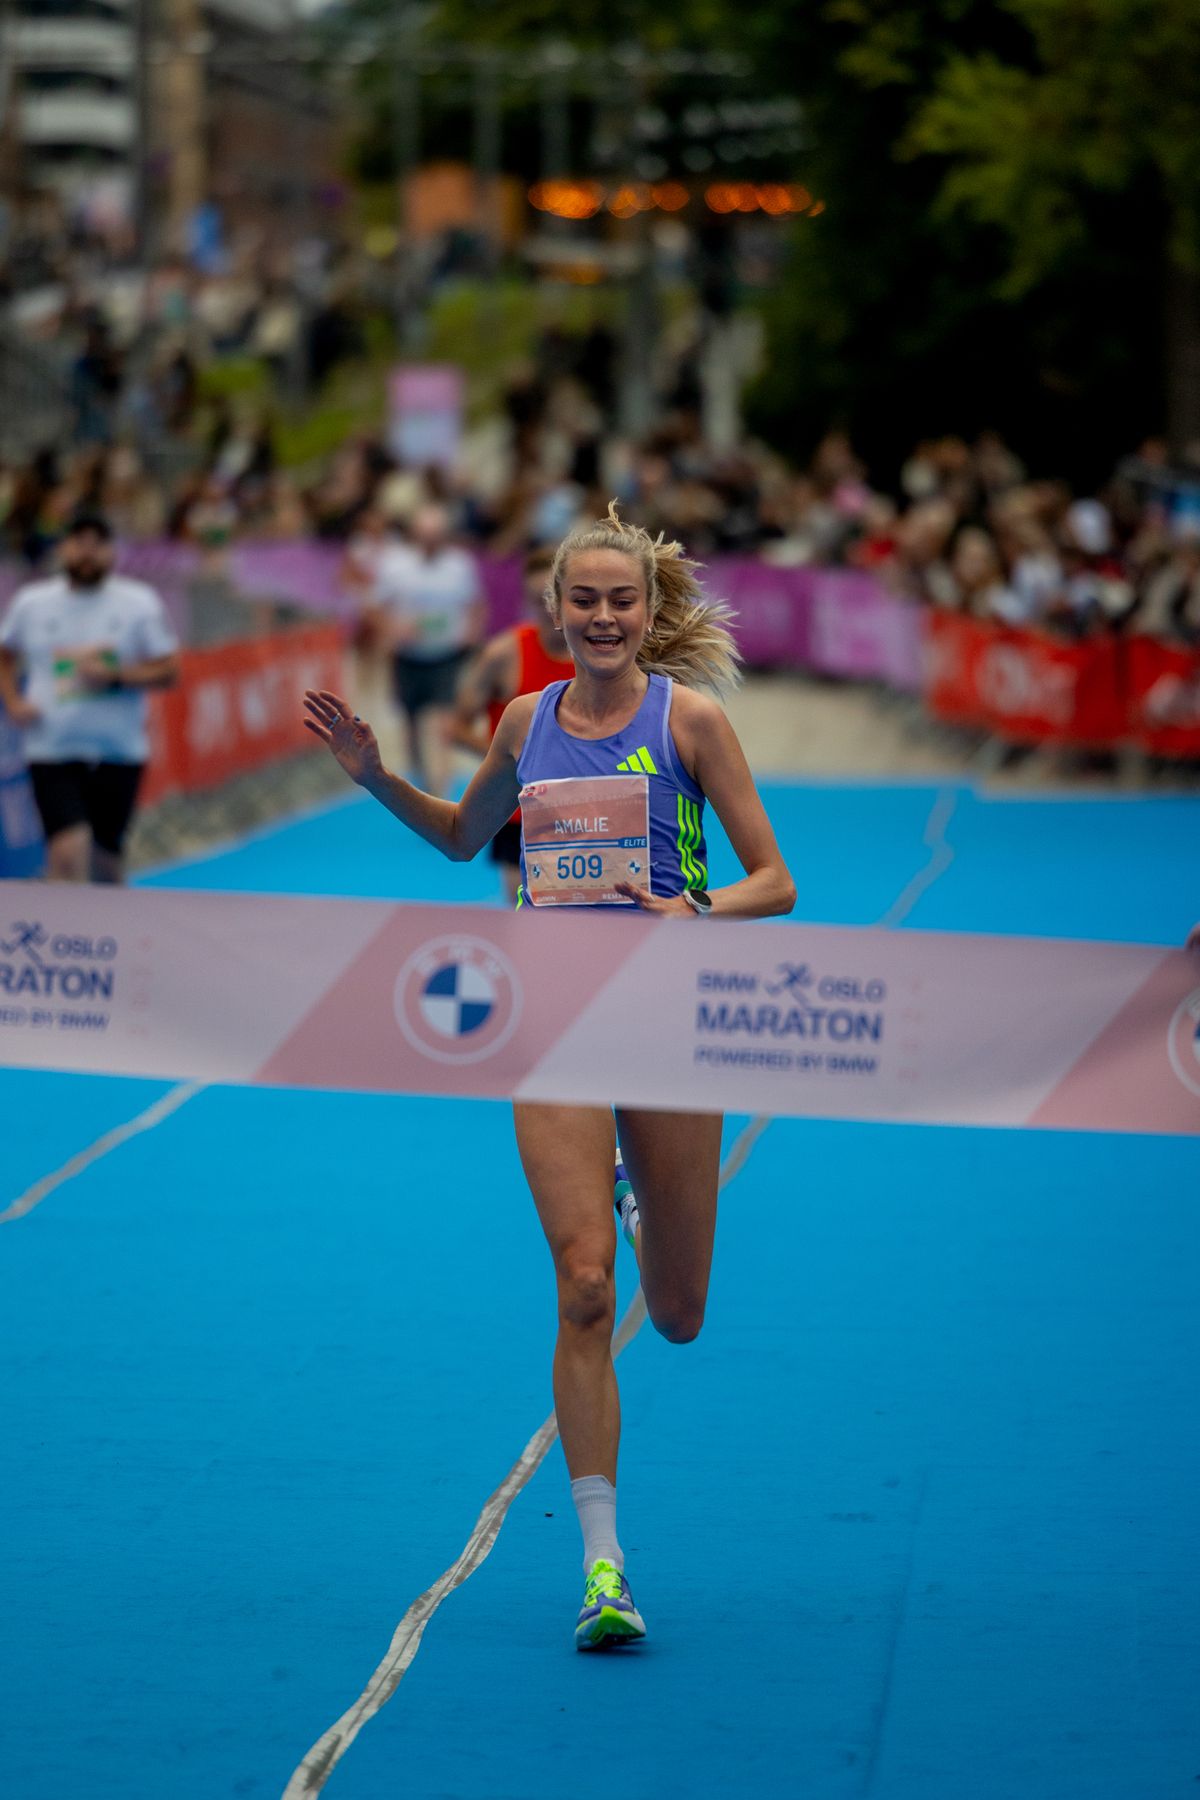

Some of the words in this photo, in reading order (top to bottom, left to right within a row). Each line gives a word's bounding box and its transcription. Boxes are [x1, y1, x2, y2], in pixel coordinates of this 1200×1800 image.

[555, 817, 609, 834] AMALIE
[623, 839, 646, 847] ELITE
[557, 855, 603, 879] 509
[51, 935, 118, 960] OSLO
[0, 964, 114, 1000] RATON
[698, 971, 757, 993] BMW
[818, 976, 887, 1003] OSLO
[697, 1002, 883, 1043] MARATON
[695, 1046, 791, 1070] POWERED
[798, 1053, 821, 1072] BY
[826, 1055, 878, 1073] BMW
